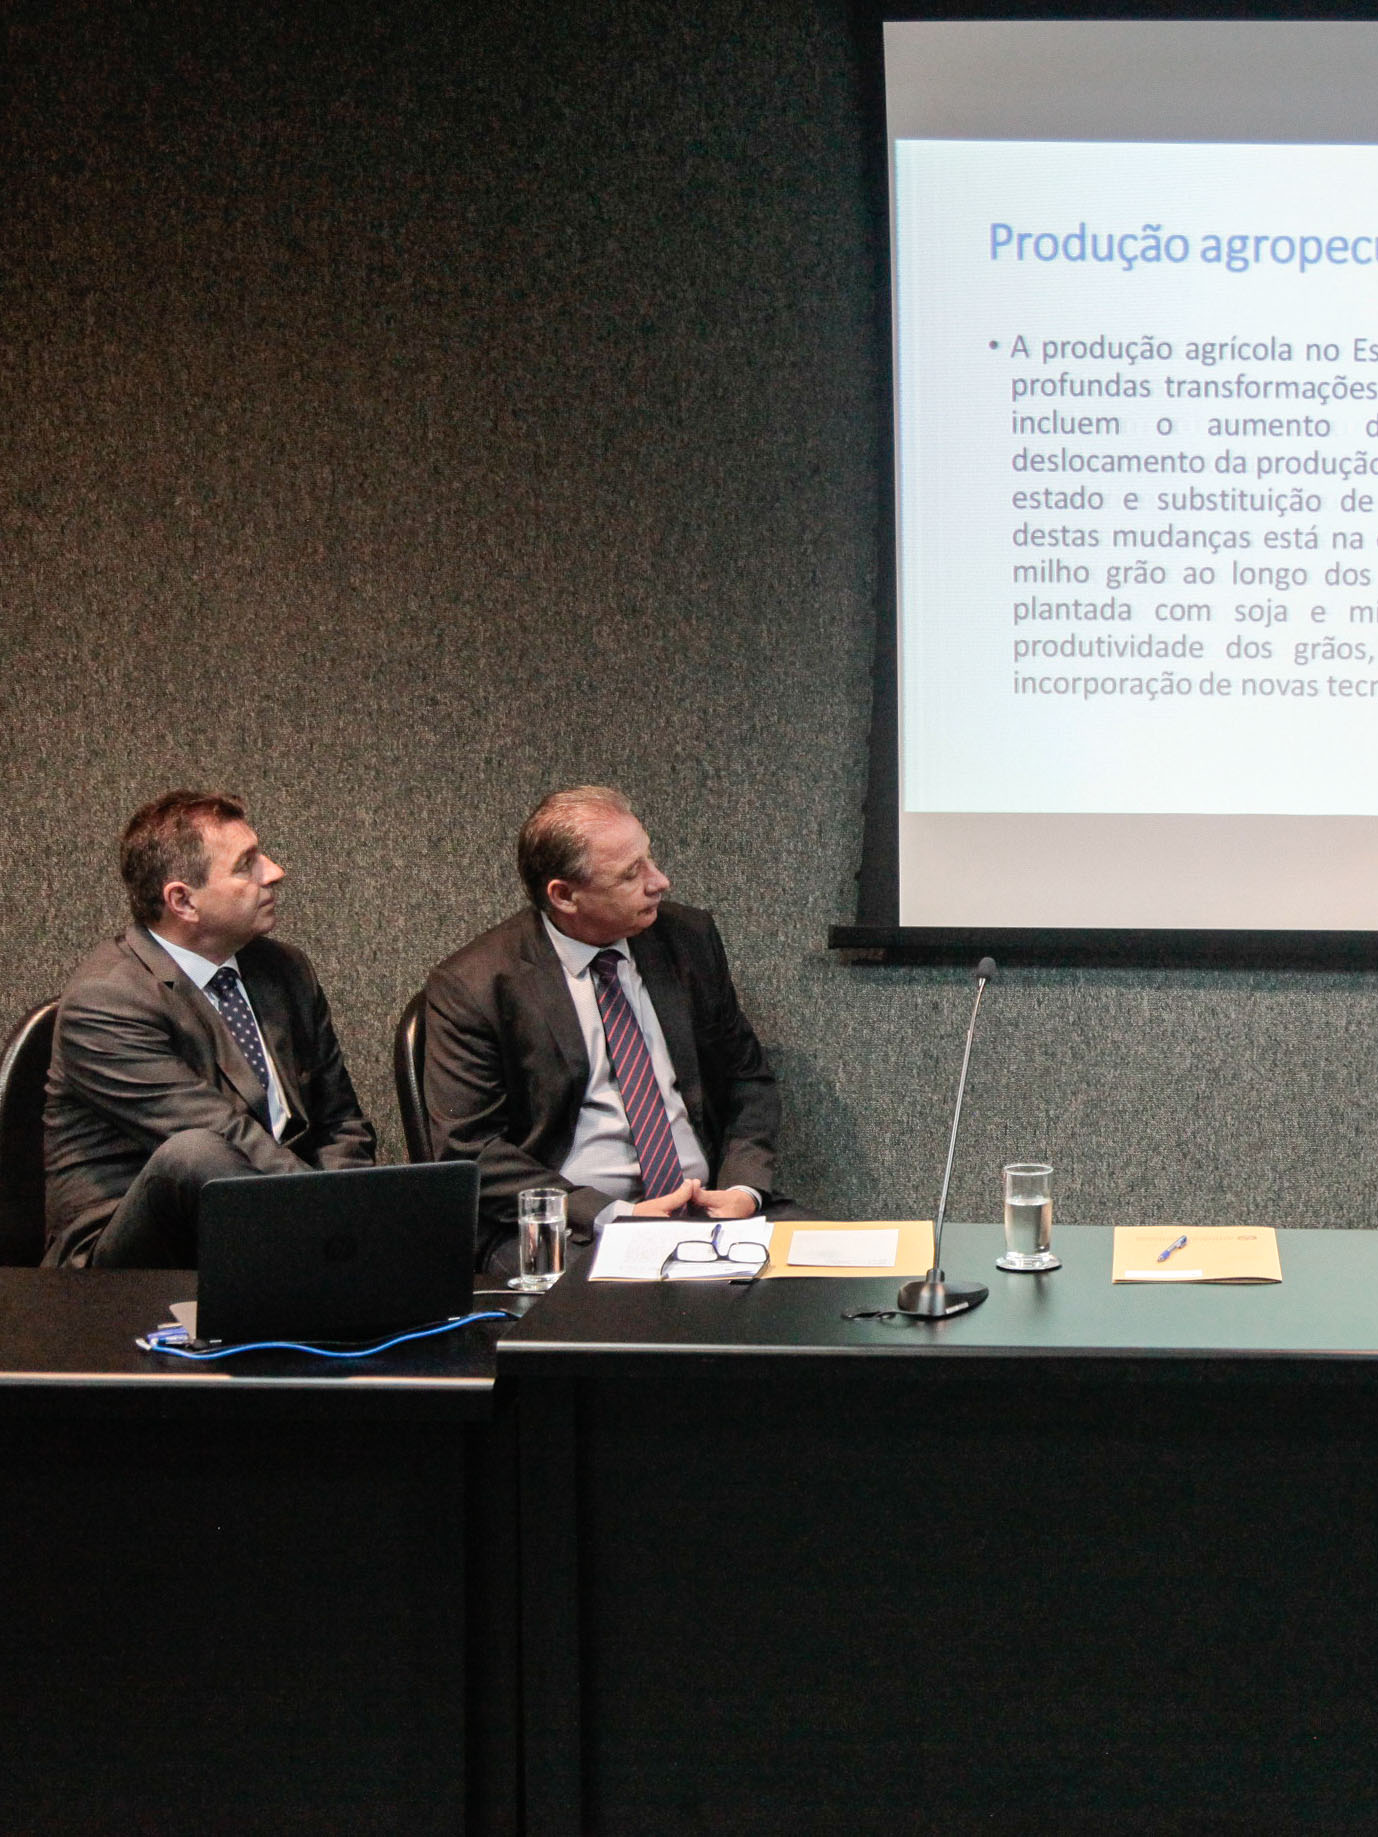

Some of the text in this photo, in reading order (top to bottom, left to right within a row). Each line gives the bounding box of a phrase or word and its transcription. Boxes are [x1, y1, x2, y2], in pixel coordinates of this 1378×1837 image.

[990, 222, 1190, 271] Produção
[1010, 334, 1031, 358] A
[1043, 334, 1173, 366] produção
[1185, 335, 1293, 366] agrícola
[1306, 344, 1341, 362] no
[1012, 371, 1153, 402] profundas
[1164, 373, 1378, 406] transformações
[1012, 409, 1120, 435] incluem
[1156, 417, 1175, 436] o
[1208, 416, 1331, 437] aumento
[1012, 446, 1206, 473] deslocamento
[1215, 449, 1248, 474] da
[1012, 485, 1104, 510] estado
[1123, 492, 1139, 510] e
[1158, 486, 1322, 518] substituição
[1340, 488, 1374, 512] de
[1013, 521, 1100, 547] destas
[1113, 523, 1252, 554] mudanças
[1264, 524, 1318, 549] está
[1332, 531, 1364, 550] na
[1013, 558, 1089, 583] milho
[1106, 560, 1167, 590] grão
[1183, 567, 1216, 585] ao
[1233, 560, 1308, 591] longo
[1325, 561, 1371, 586] dos
[1014, 595, 1132, 626] plantada
[1155, 603, 1211, 621] com
[1235, 598, 1288, 628] soja
[1311, 605, 1326, 623] e
[1014, 633, 1204, 663] produtividade
[1226, 634, 1272, 659] dos
[1294, 636, 1374, 666] grãos,
[1014, 670, 1192, 701] incorporação
[1199, 671, 1232, 696] de
[1242, 678, 1319, 697] novas
